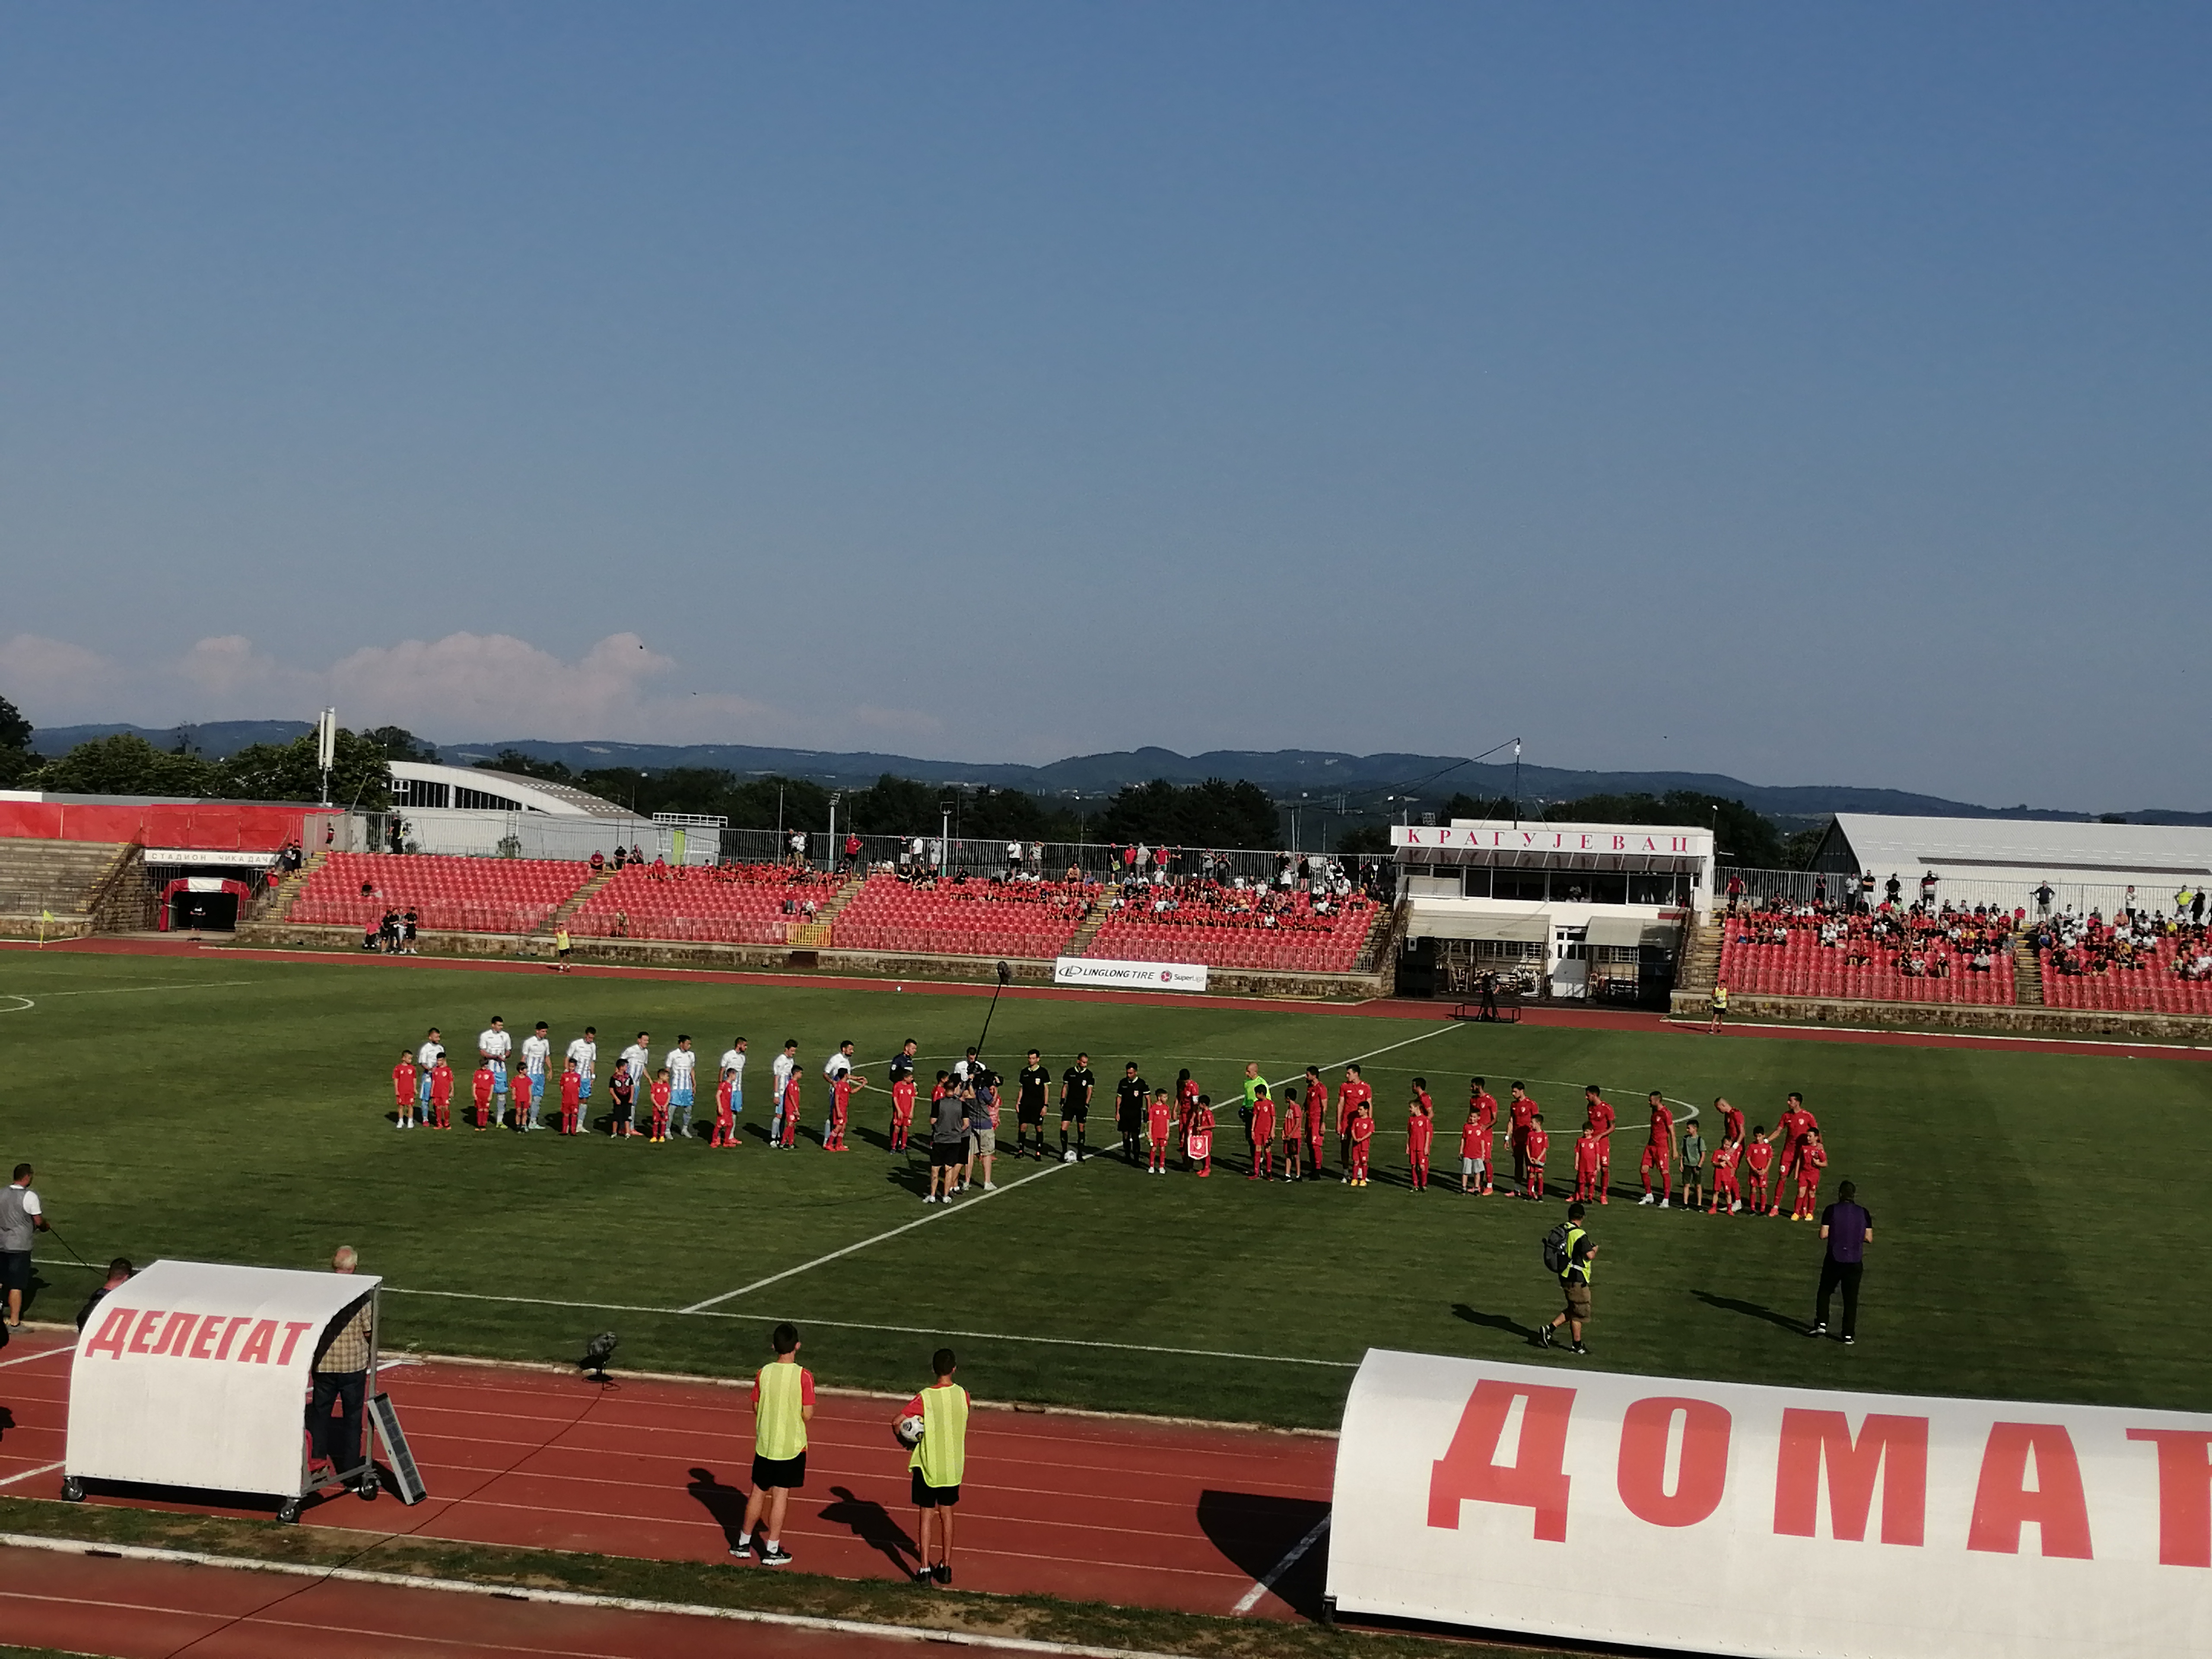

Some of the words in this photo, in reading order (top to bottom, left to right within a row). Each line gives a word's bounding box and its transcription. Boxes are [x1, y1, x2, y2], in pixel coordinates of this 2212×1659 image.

[1406, 828, 1688, 855] КРАГУЈЕВАЦ
[152, 852, 207, 861] СТАДИОН
[1083, 968, 1130, 978] LINGLONG
[1132, 970, 1155, 980] TIRE
[85, 1308, 312, 1365] ДЕЛЕГАТ
